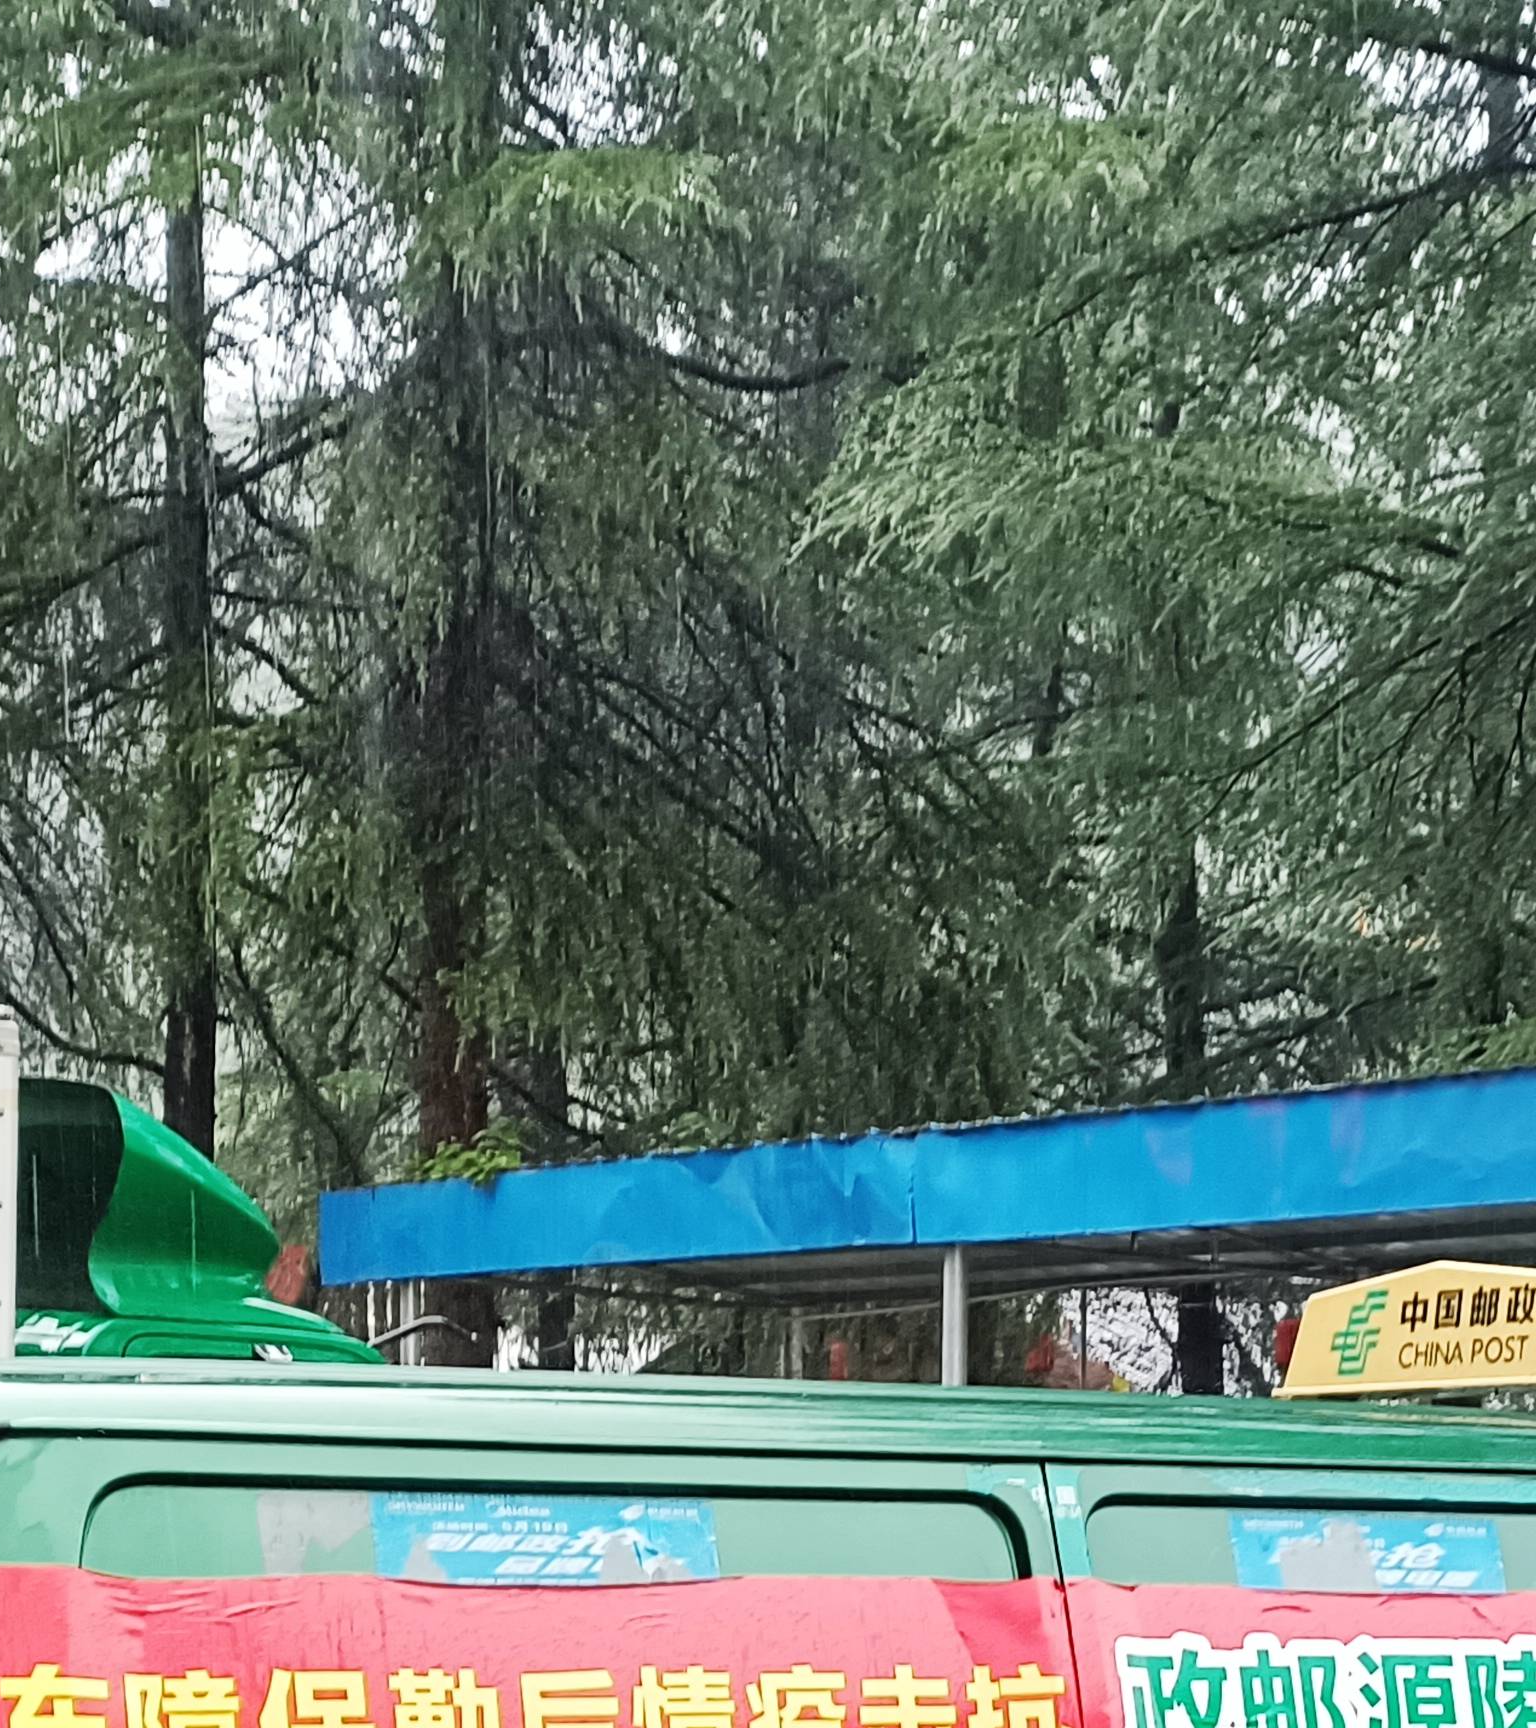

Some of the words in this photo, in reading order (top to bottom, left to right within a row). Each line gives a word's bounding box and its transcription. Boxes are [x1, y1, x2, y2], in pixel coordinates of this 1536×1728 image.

[1399, 1283, 1536, 1333] 中国邮政
[1398, 1340, 1464, 1369] CHINA
[1470, 1334, 1529, 1364] POST
